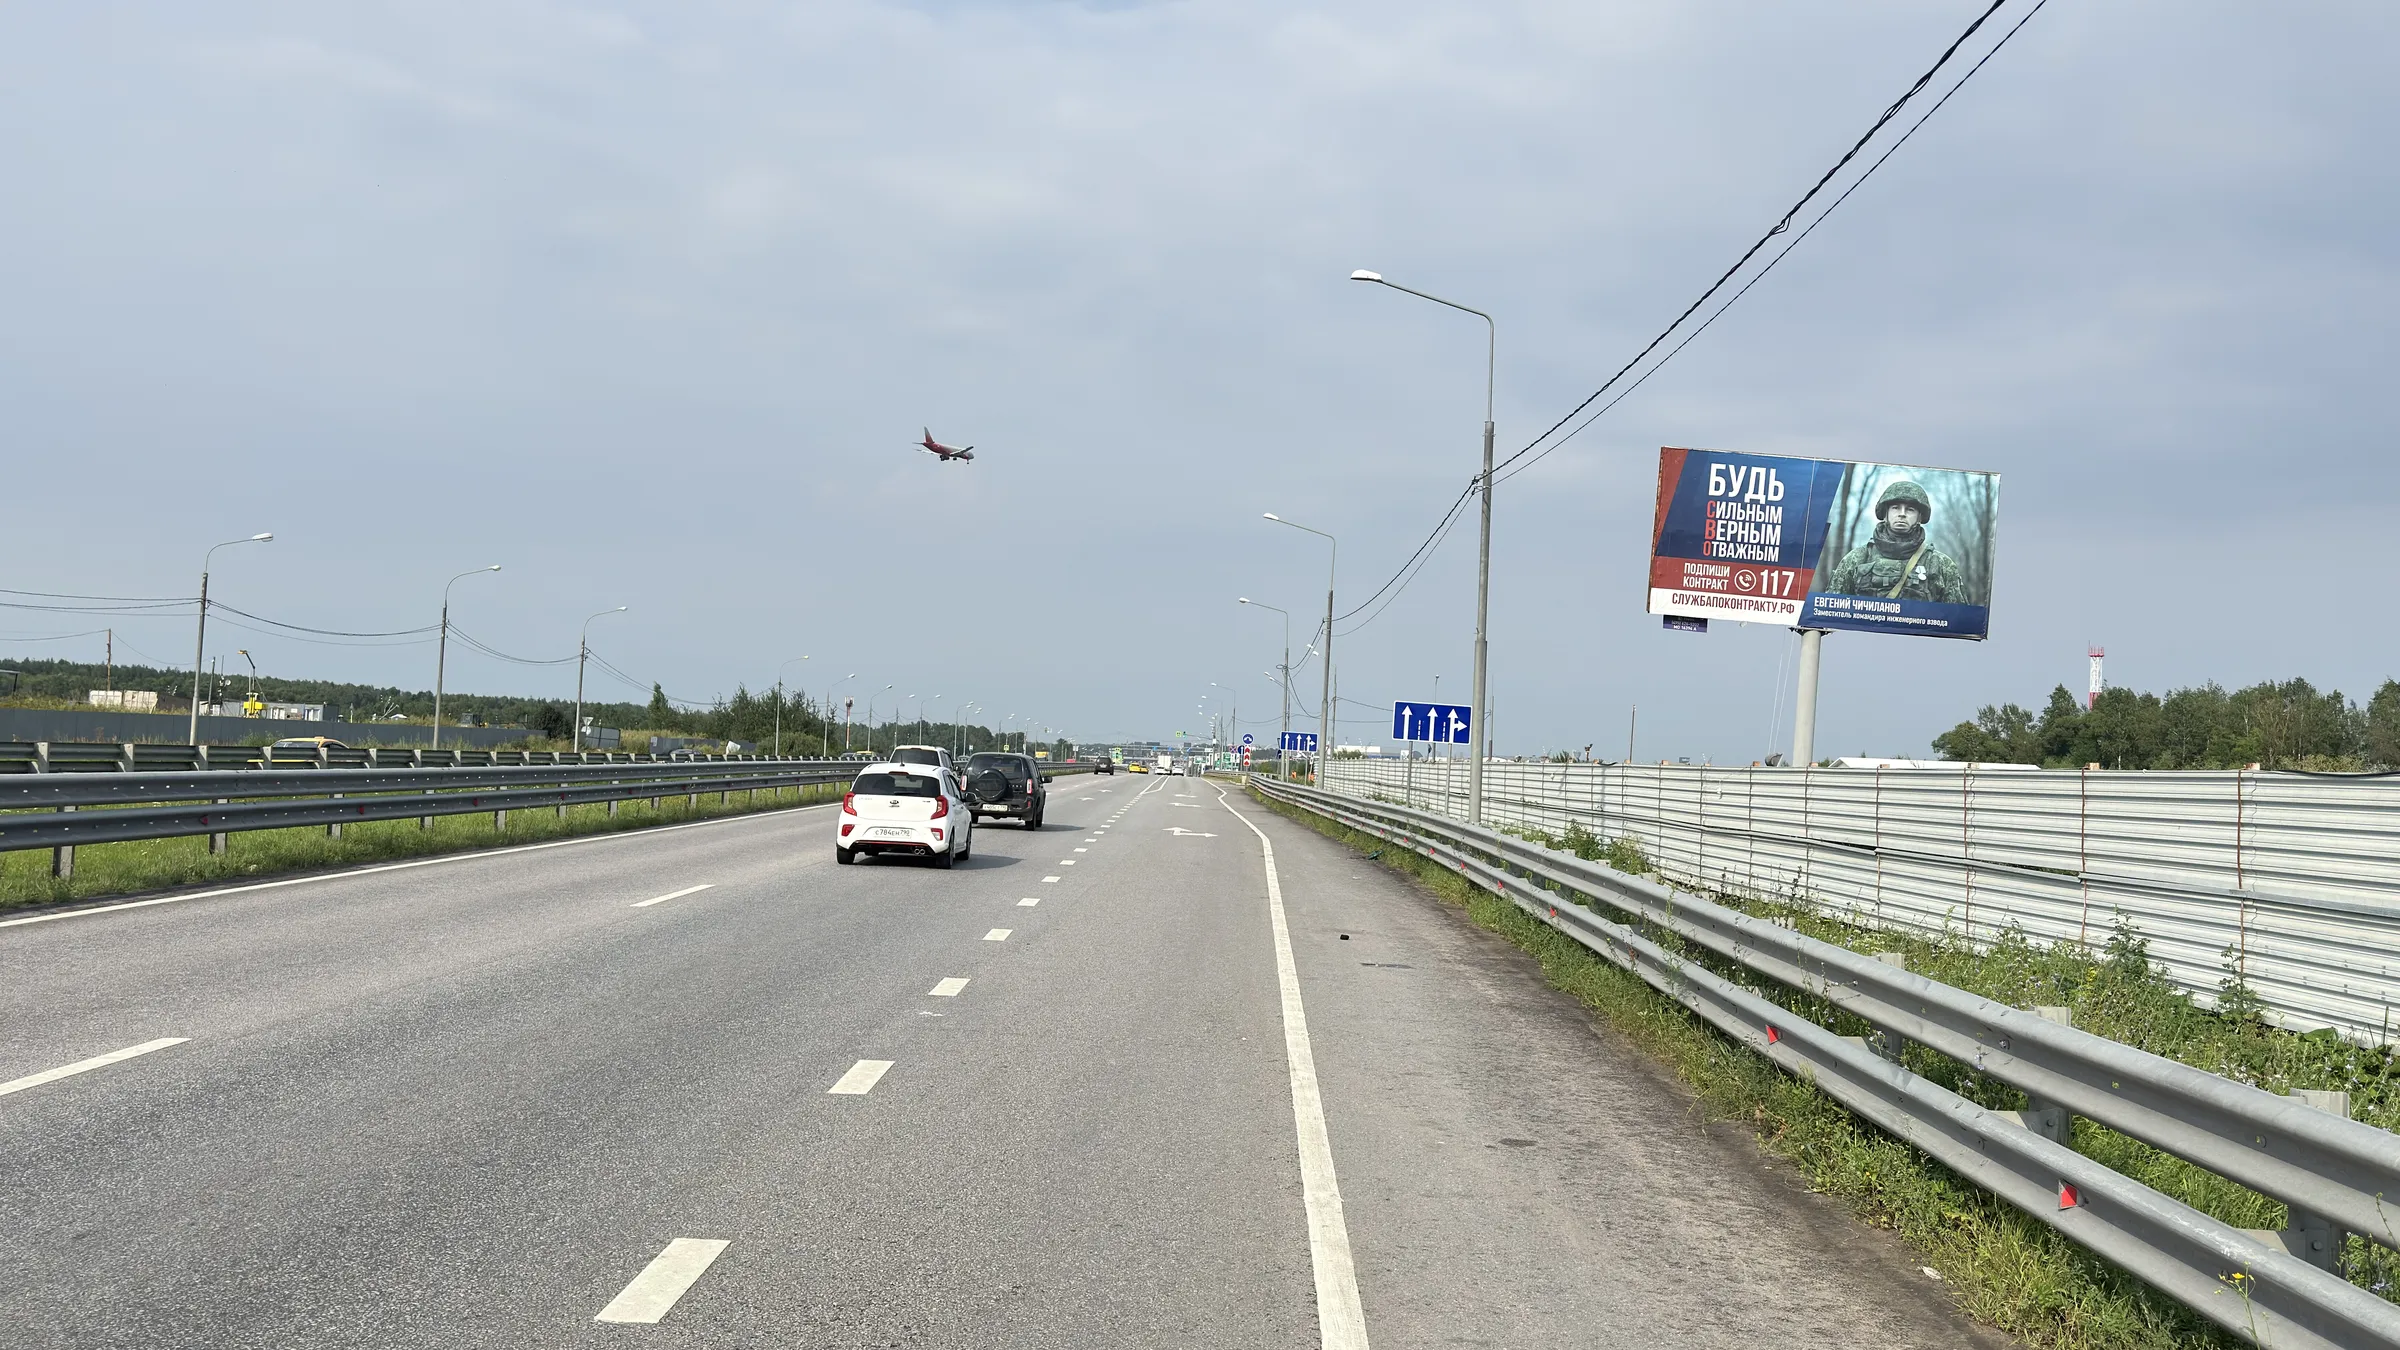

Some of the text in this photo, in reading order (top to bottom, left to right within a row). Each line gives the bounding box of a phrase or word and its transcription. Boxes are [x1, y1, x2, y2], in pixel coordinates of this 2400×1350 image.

[1708, 463, 1785, 504] БУДЬ
[1706, 500, 1782, 524] СИЛЬНЫМ
[1704, 519, 1781, 545] ВЕРНЫМ
[1703, 540, 1779, 562] ОТВАЖНЫМ
[1684, 562, 1730, 578] ПОДПИШИ
[1683, 575, 1729, 590] КОНТРАКТ
[1760, 569, 1795, 597] 117
[1672, 593, 1795, 614] СЛУЖБАПОКОНТРАКТУ.РФ
[1814, 596, 1901, 614] ЕВГЕНИЙ ЧИЧИЛАНОВ
[1813, 608, 1948, 627] Заместитель командира инженерного взвода
